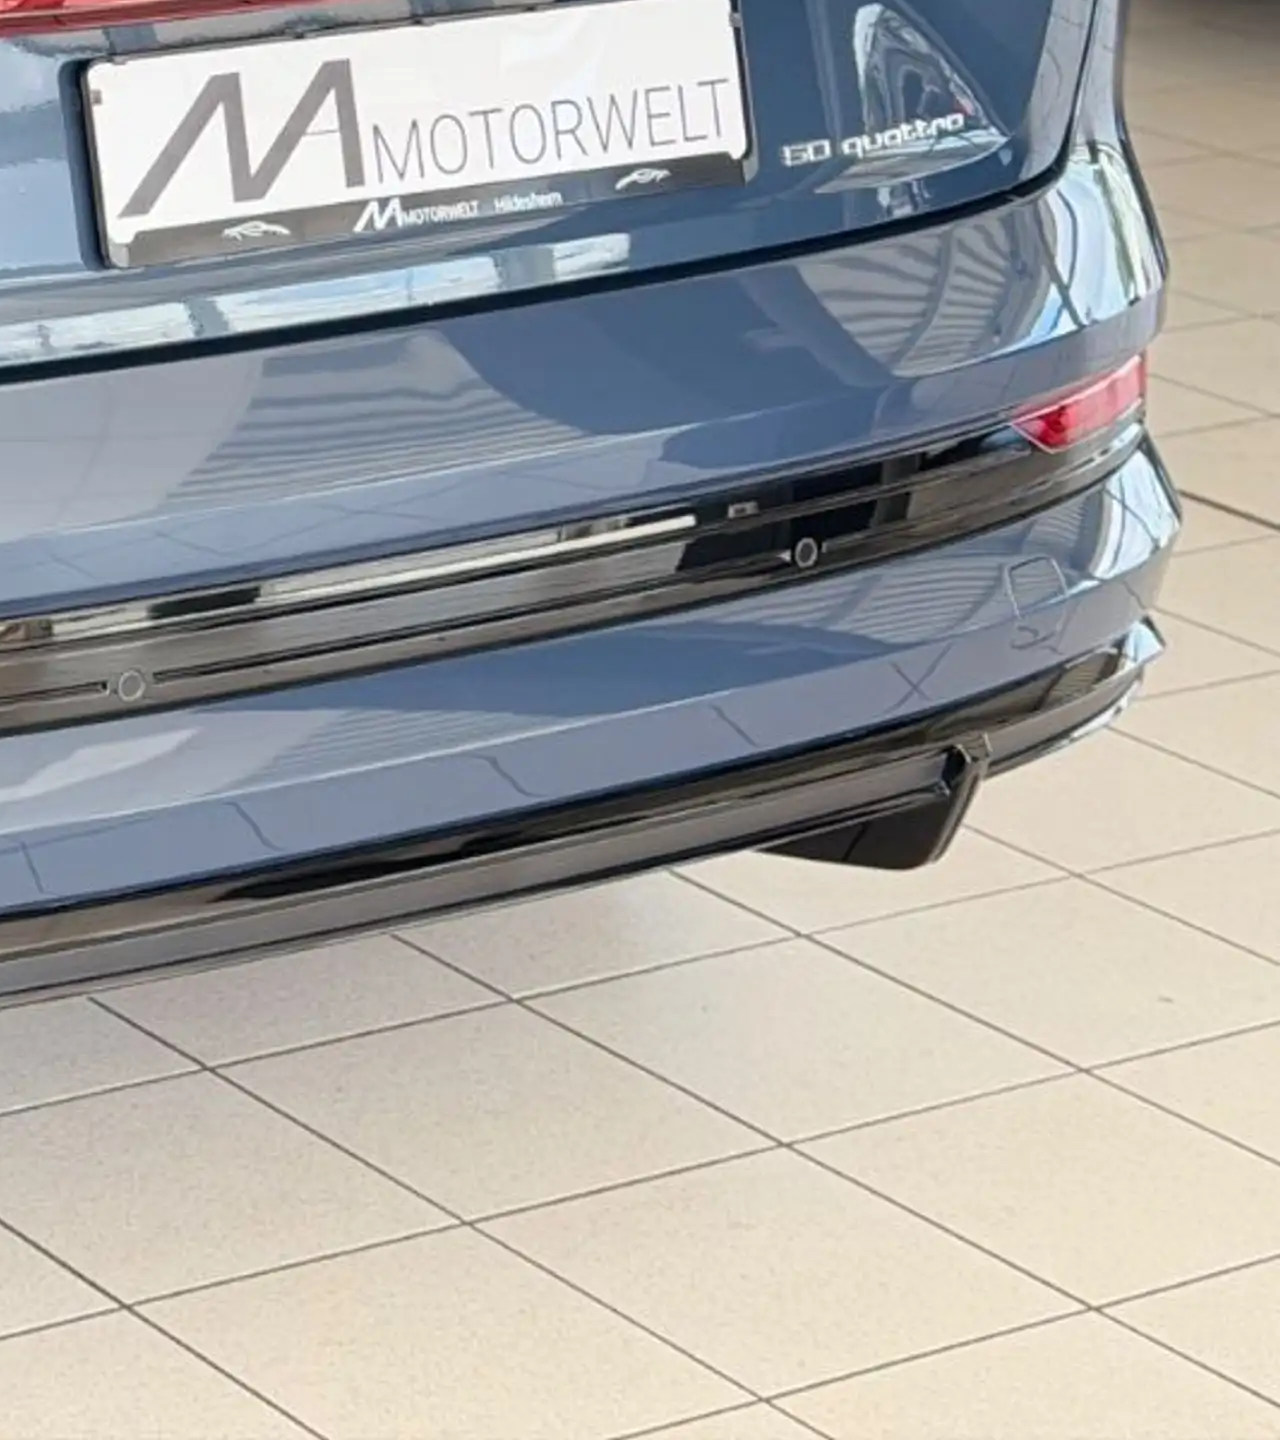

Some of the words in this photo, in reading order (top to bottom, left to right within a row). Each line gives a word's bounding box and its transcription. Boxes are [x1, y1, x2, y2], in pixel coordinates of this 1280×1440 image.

[370, 78, 730, 184] MOTORWELT
[842, 113, 964, 157] quattro
[403, 201, 479, 225] MOTORWELT
